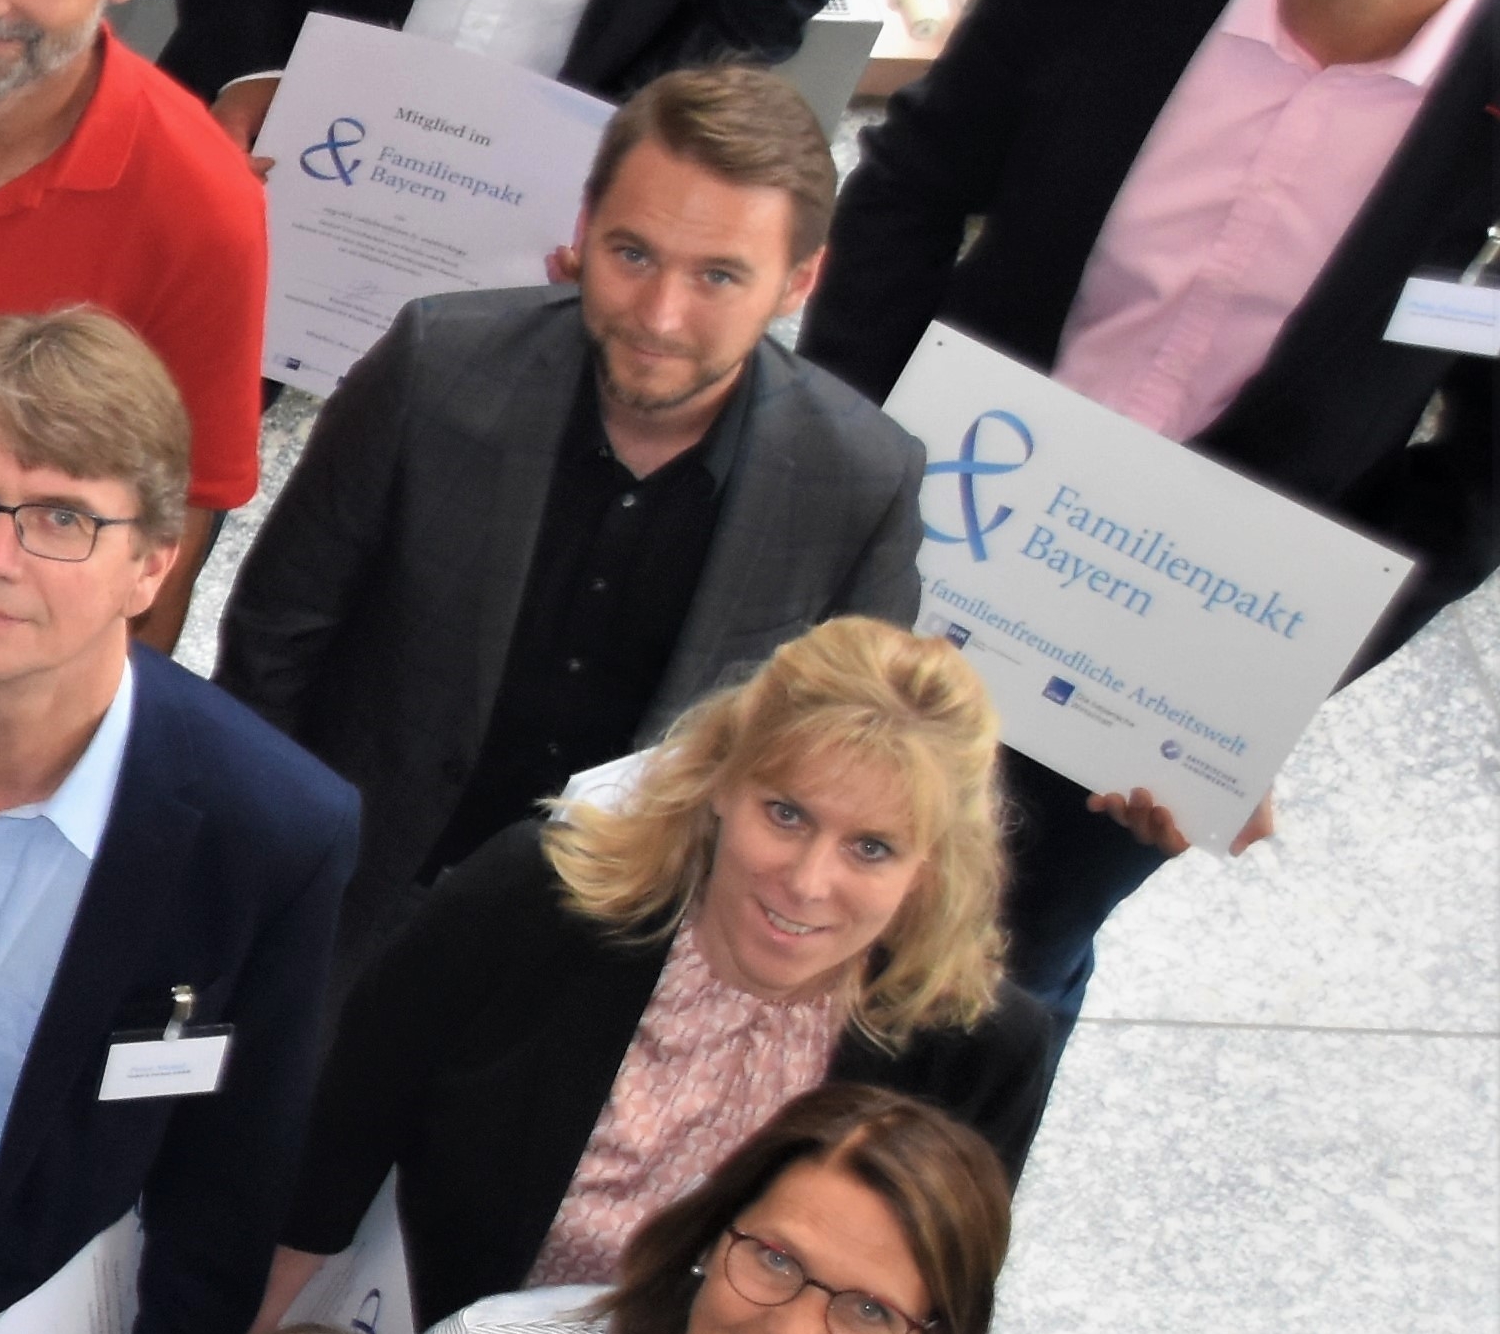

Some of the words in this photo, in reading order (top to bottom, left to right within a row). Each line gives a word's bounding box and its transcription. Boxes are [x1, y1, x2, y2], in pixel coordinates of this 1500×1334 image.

[394, 107, 466, 140] Mitglied
[468, 128, 492, 147] im
[370, 167, 447, 204] Bayern
[377, 146, 524, 206] Familienpakt
[1018, 524, 1154, 618] Bayern
[1042, 484, 1306, 641] Familienpakt
[928, 577, 1128, 695] familienfreundliche
[1126, 686, 1249, 757] Arbeitswelt
